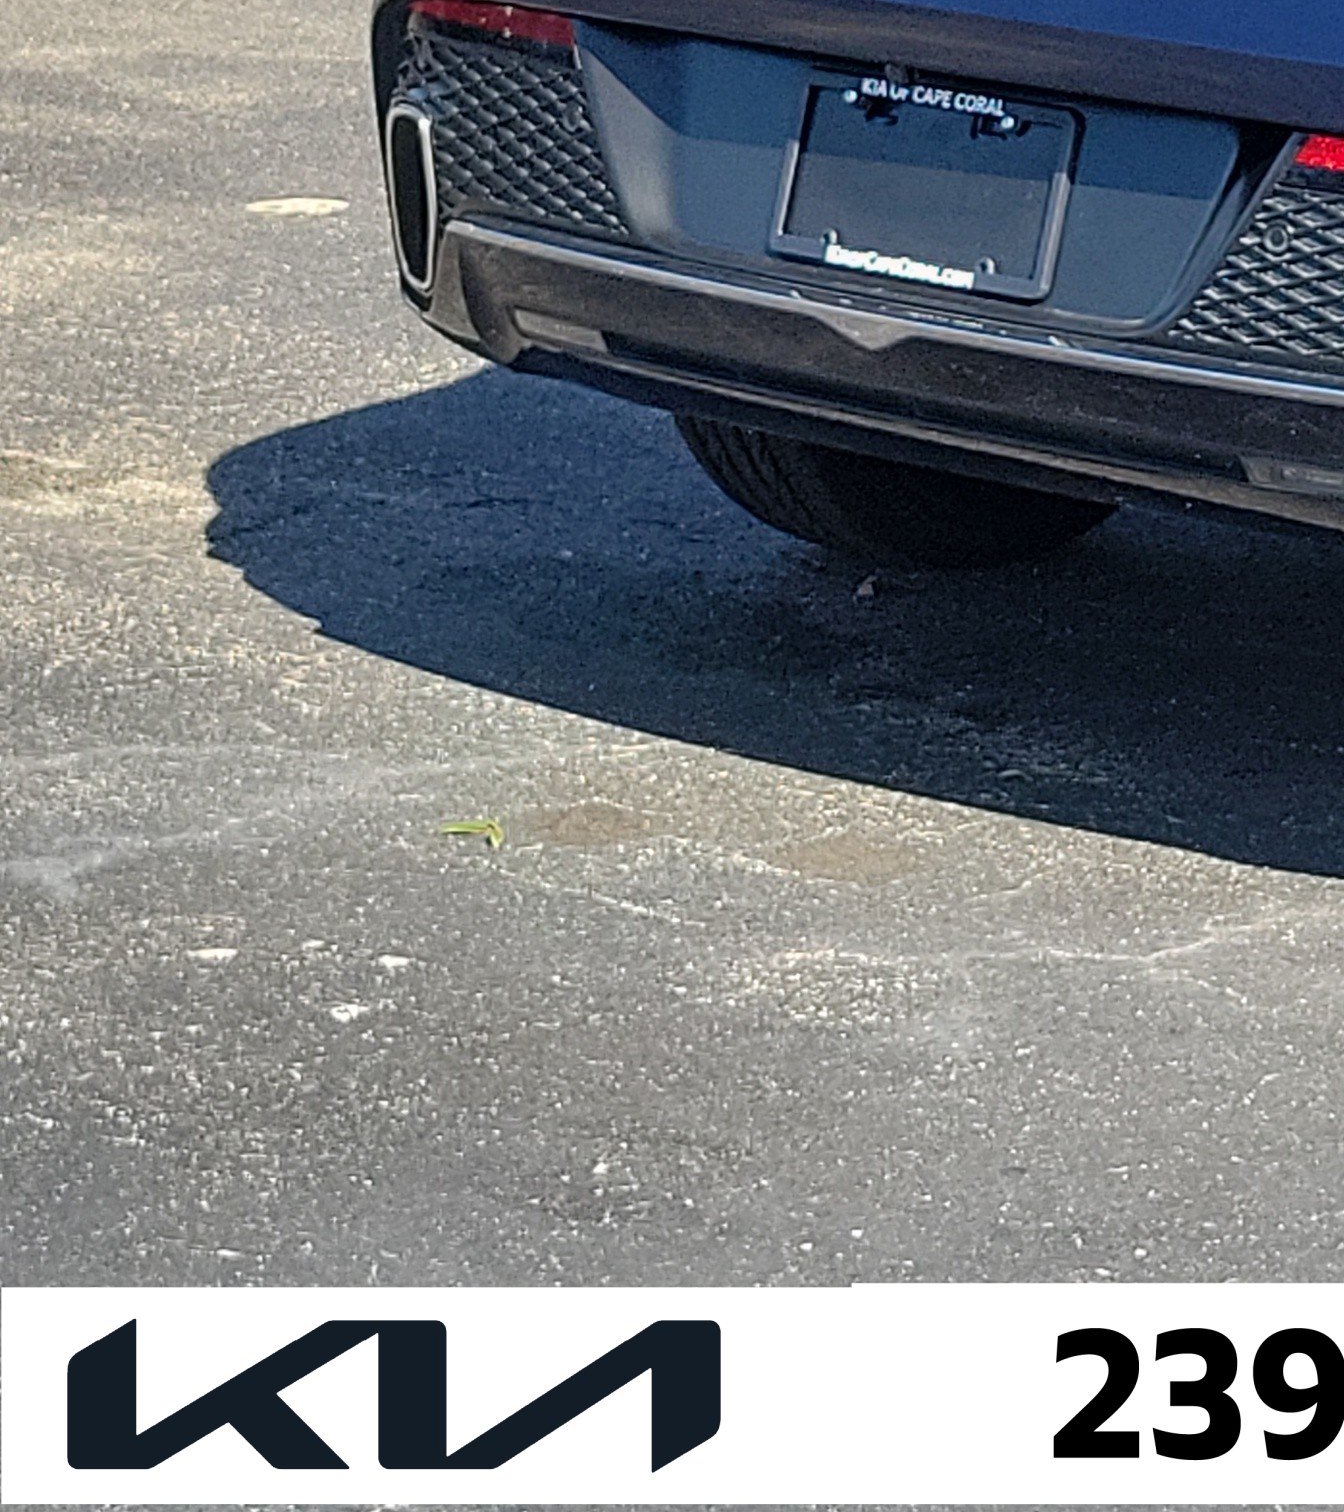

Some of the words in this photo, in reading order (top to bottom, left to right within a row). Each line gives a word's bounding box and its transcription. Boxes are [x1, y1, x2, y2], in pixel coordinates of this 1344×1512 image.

[861, 77, 888, 98] KIA
[912, 85, 953, 109] CAPE
[954, 92, 1005, 117] CORAL
